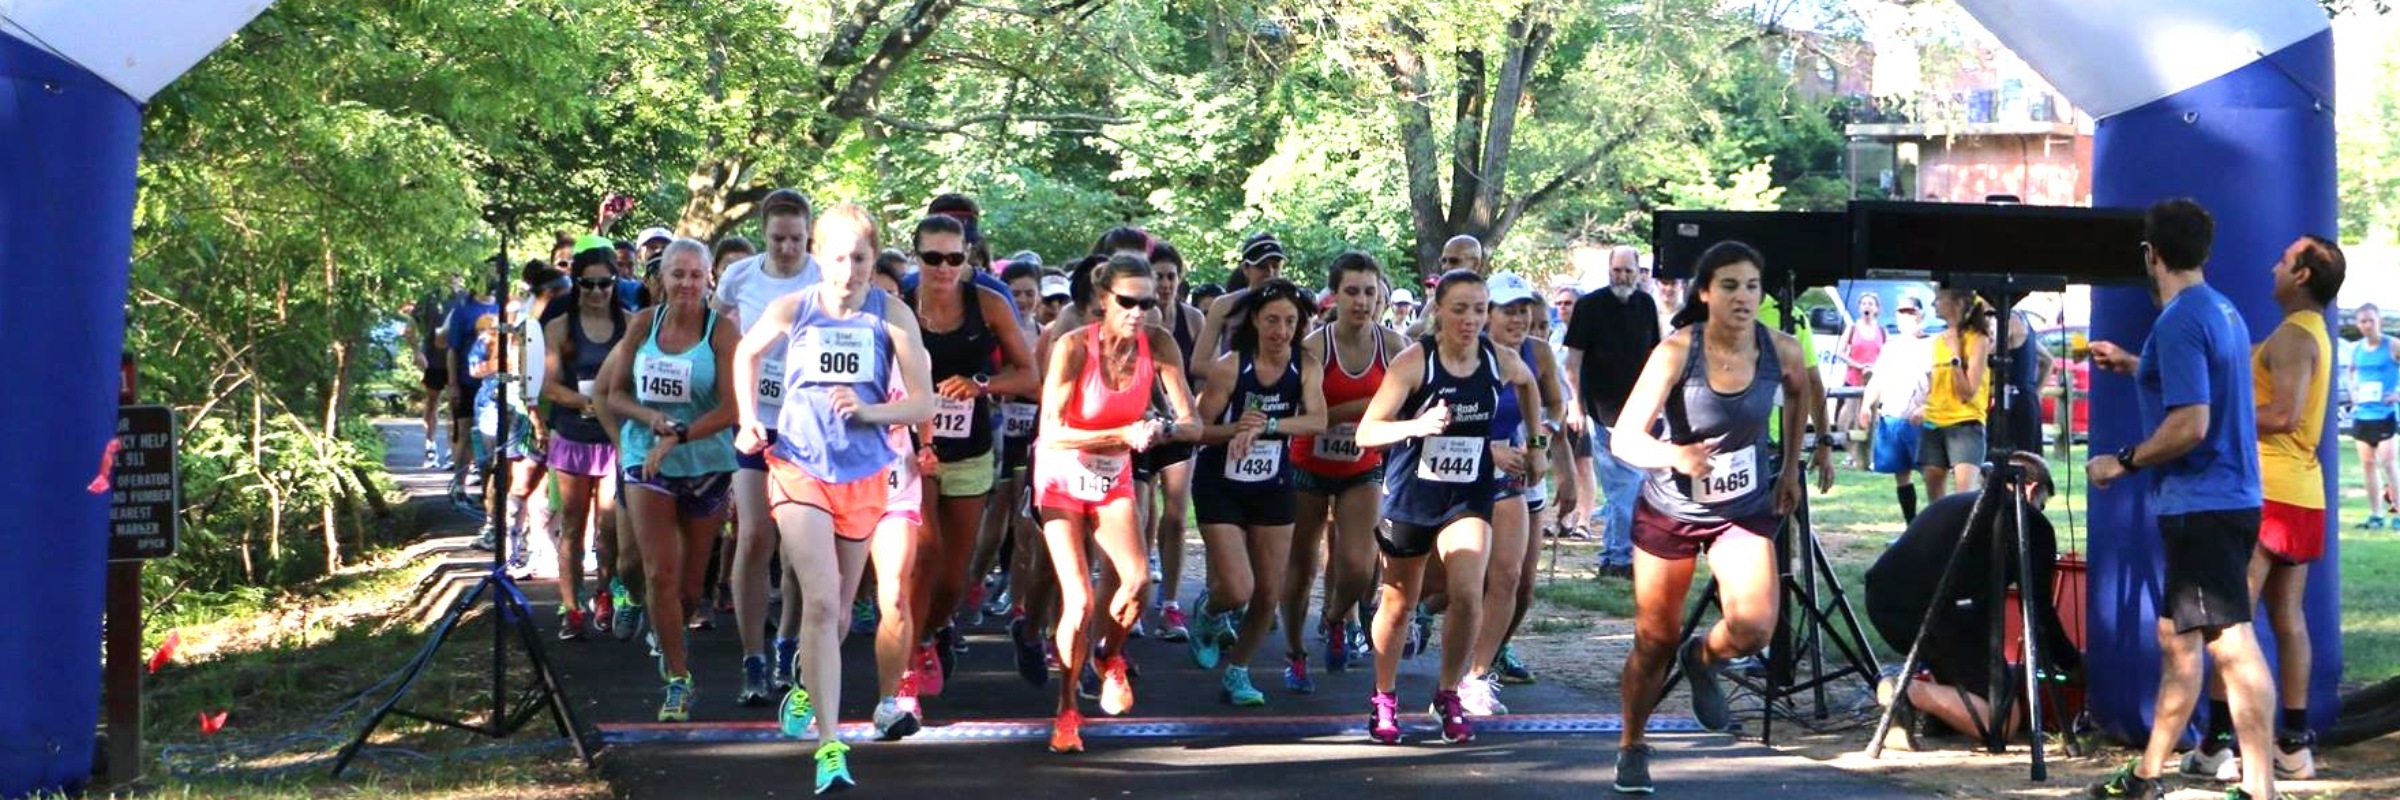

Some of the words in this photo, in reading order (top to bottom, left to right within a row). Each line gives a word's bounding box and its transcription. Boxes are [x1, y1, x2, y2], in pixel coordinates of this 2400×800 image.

[820, 352, 859, 374] 906
[642, 375, 683, 397] 1455
[932, 413, 965, 431] 412
[140, 432, 169, 448] HELP
[1235, 457, 1273, 476] 1434
[1430, 456, 1474, 476] 1444
[117, 472, 171, 488] OPERATOR
[1701, 468, 1750, 496] 1465
